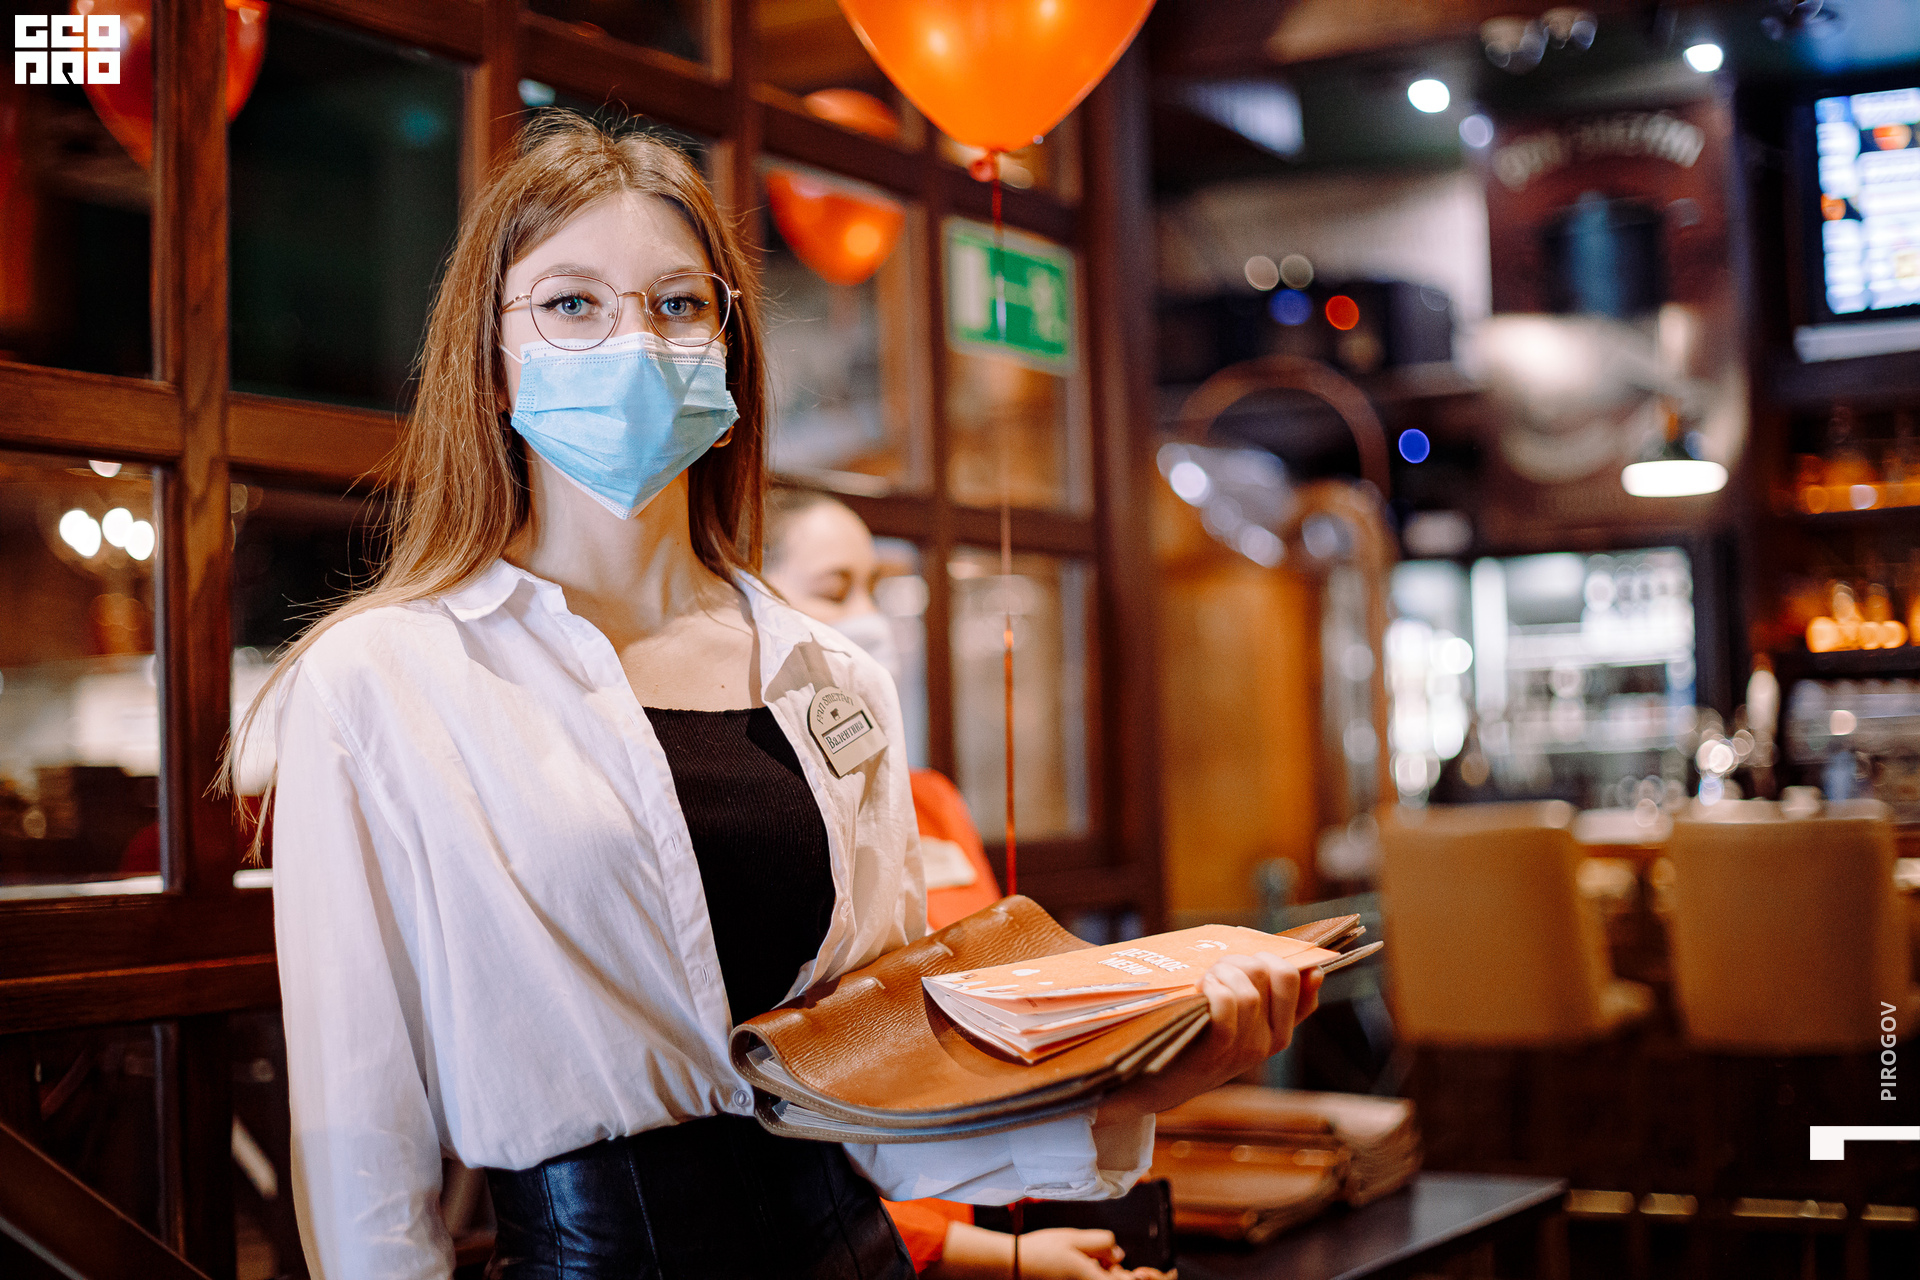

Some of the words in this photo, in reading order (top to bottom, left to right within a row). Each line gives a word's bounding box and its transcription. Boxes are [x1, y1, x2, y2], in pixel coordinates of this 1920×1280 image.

[826, 721, 865, 749] Валентина
[1097, 957, 1153, 975] МЕНЮ
[1110, 948, 1190, 972] ДЕТСКОЕ
